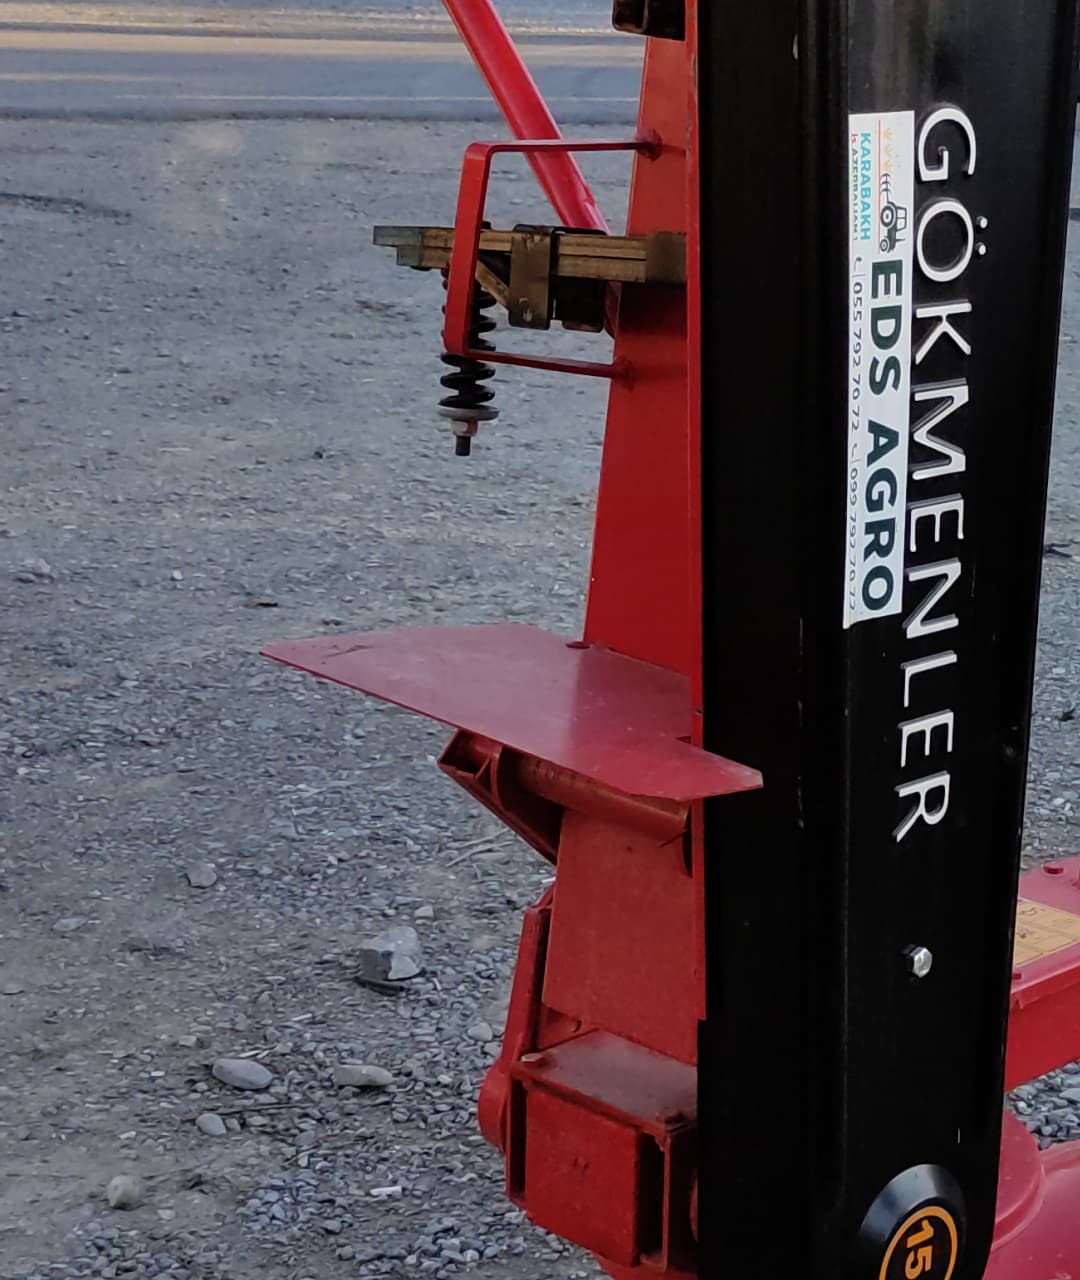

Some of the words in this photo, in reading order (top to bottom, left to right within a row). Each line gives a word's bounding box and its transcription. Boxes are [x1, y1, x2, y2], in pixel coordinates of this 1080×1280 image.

[860, 132, 871, 240] KARABAKH
[852, 282, 863, 322] 055
[868, 259, 903, 396] EDS
[852, 329, 862, 368] 792
[852, 374, 861, 401] 70
[851, 406, 860, 432] 72
[849, 468, 858, 506] 099
[895, 106, 988, 843] GÖKMENLER
[849, 511, 857, 550] 792
[861, 419, 900, 612] AGRO
[904, 1219, 935, 1280] 15
